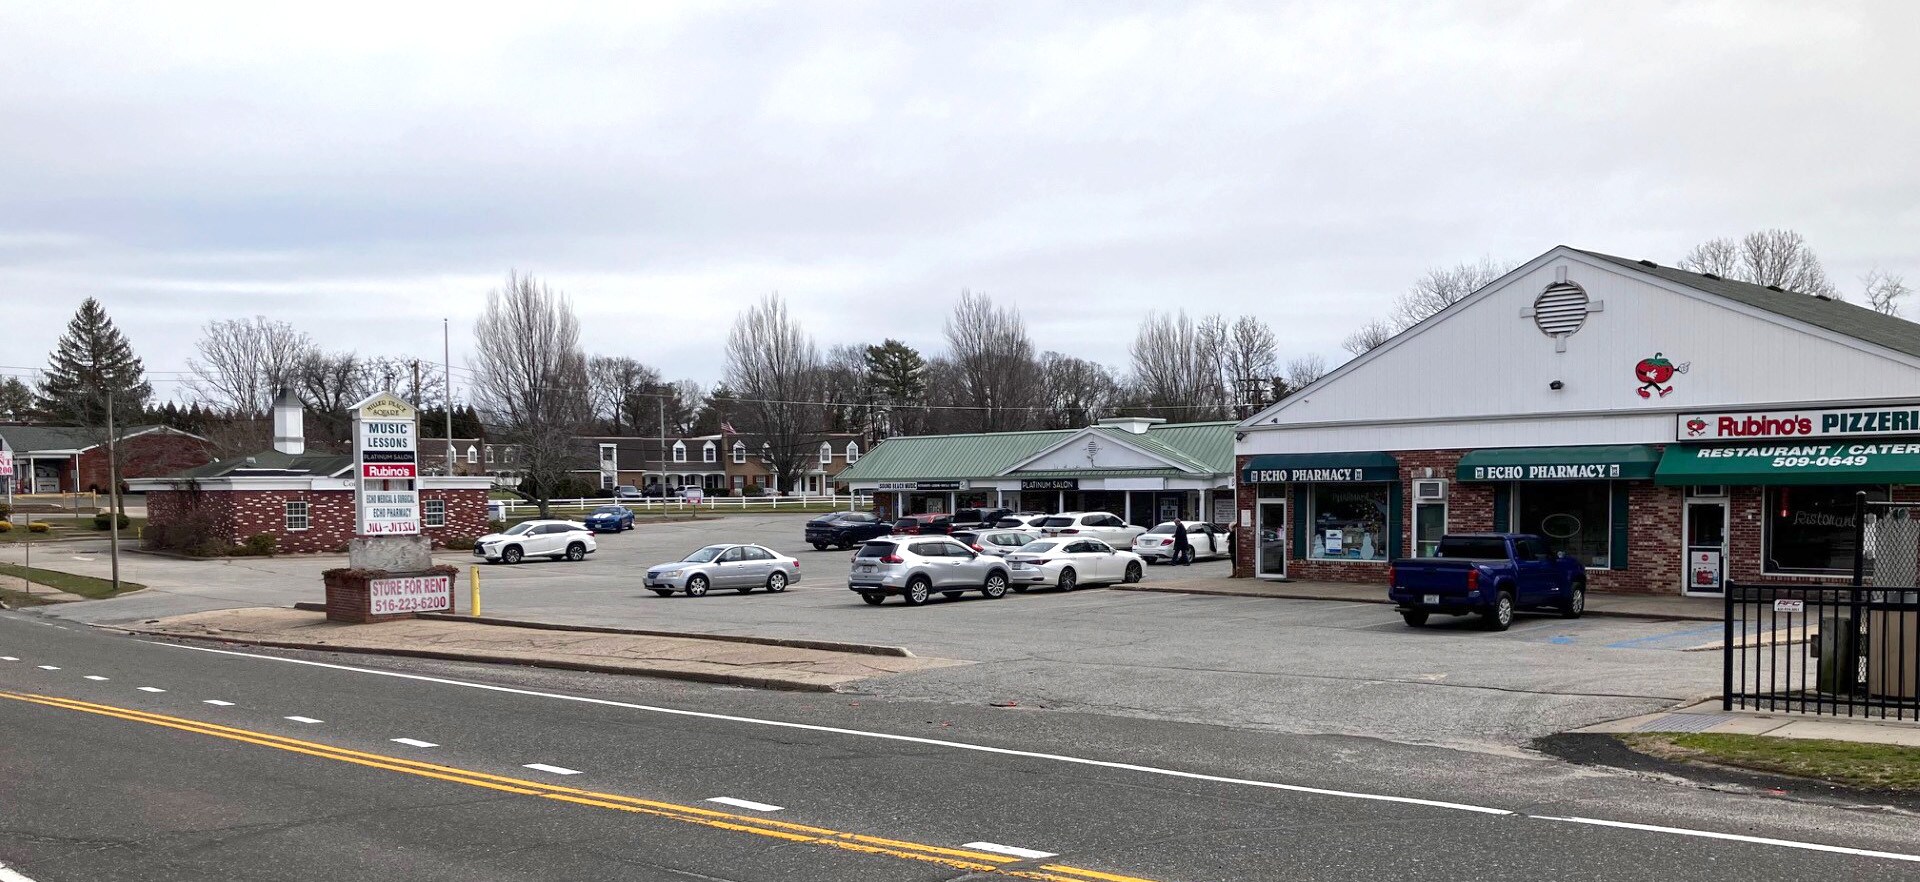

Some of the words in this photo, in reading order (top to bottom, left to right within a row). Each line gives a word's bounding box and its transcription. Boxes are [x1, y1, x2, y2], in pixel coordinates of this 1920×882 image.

[369, 423, 408, 434] MUSIC
[1717, 415, 1812, 437] Rubino's
[1822, 411, 1920, 433] PIZZERI
[368, 437, 408, 448] LESSONS
[1697, 445, 1831, 458] RESTAURANT
[1772, 456, 1868, 467] 509-0649
[369, 465, 410, 477] Rubino's
[1260, 470, 1287, 482] ECHO
[1292, 468, 1352, 481] PHARMACY
[1487, 466, 1523, 479] ECHO
[1529, 464, 1606, 478] PHARMACY
[1022, 481, 1051, 489] PLATINUM
[1052, 480, 1073, 489] SALON
[373, 508, 386, 518] ECHO
[387, 508, 411, 518] PHARMACY
[366, 522, 416, 533] JIU-JITSU
[373, 580, 402, 596] STORE
[404, 579, 422, 594] FOR
[424, 578, 447, 593] RENT
[375, 596, 446, 611] 516-223-6200
